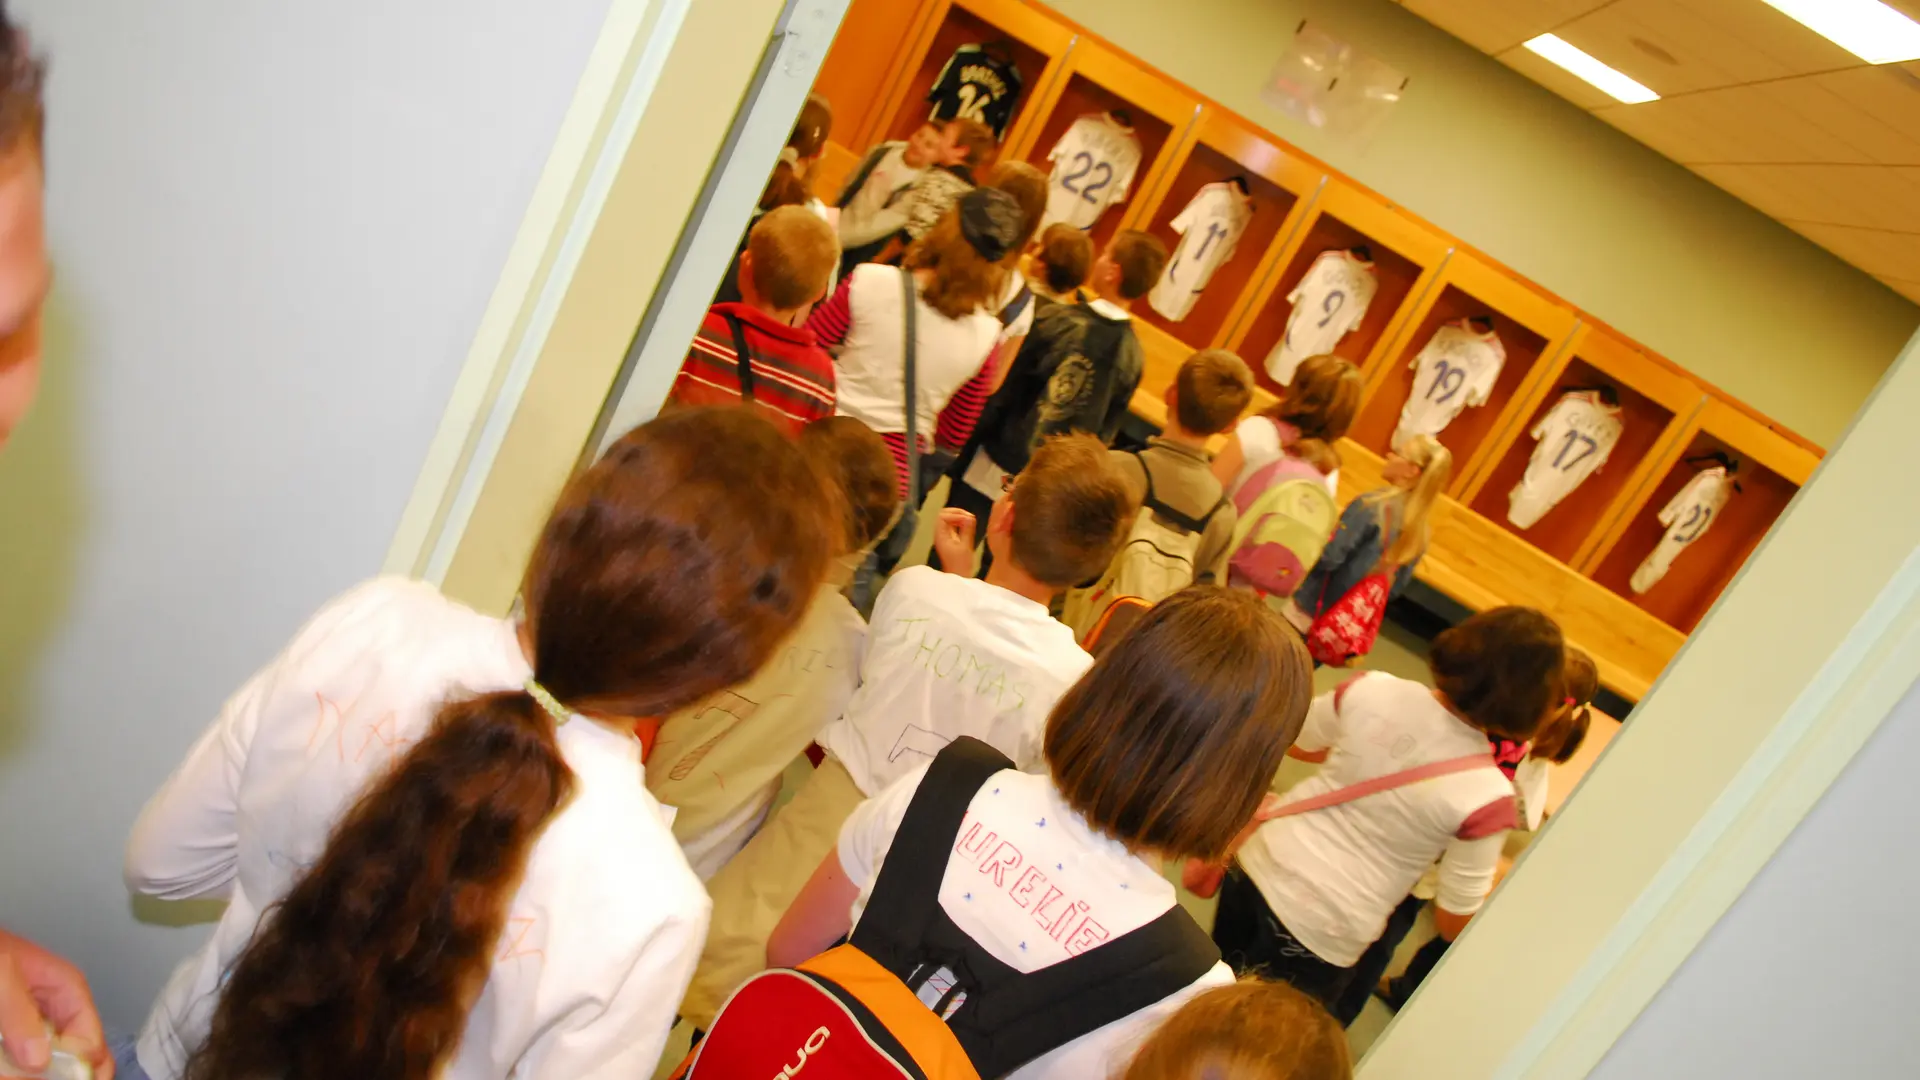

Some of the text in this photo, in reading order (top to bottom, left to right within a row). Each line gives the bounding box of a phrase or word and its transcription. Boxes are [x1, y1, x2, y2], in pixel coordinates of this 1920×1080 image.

[1060, 150, 1114, 204] 22
[1316, 289, 1346, 329] 9
[1424, 359, 1467, 406] 19
[1552, 429, 1598, 474] 17
[896, 618, 1036, 713] THOMAS
